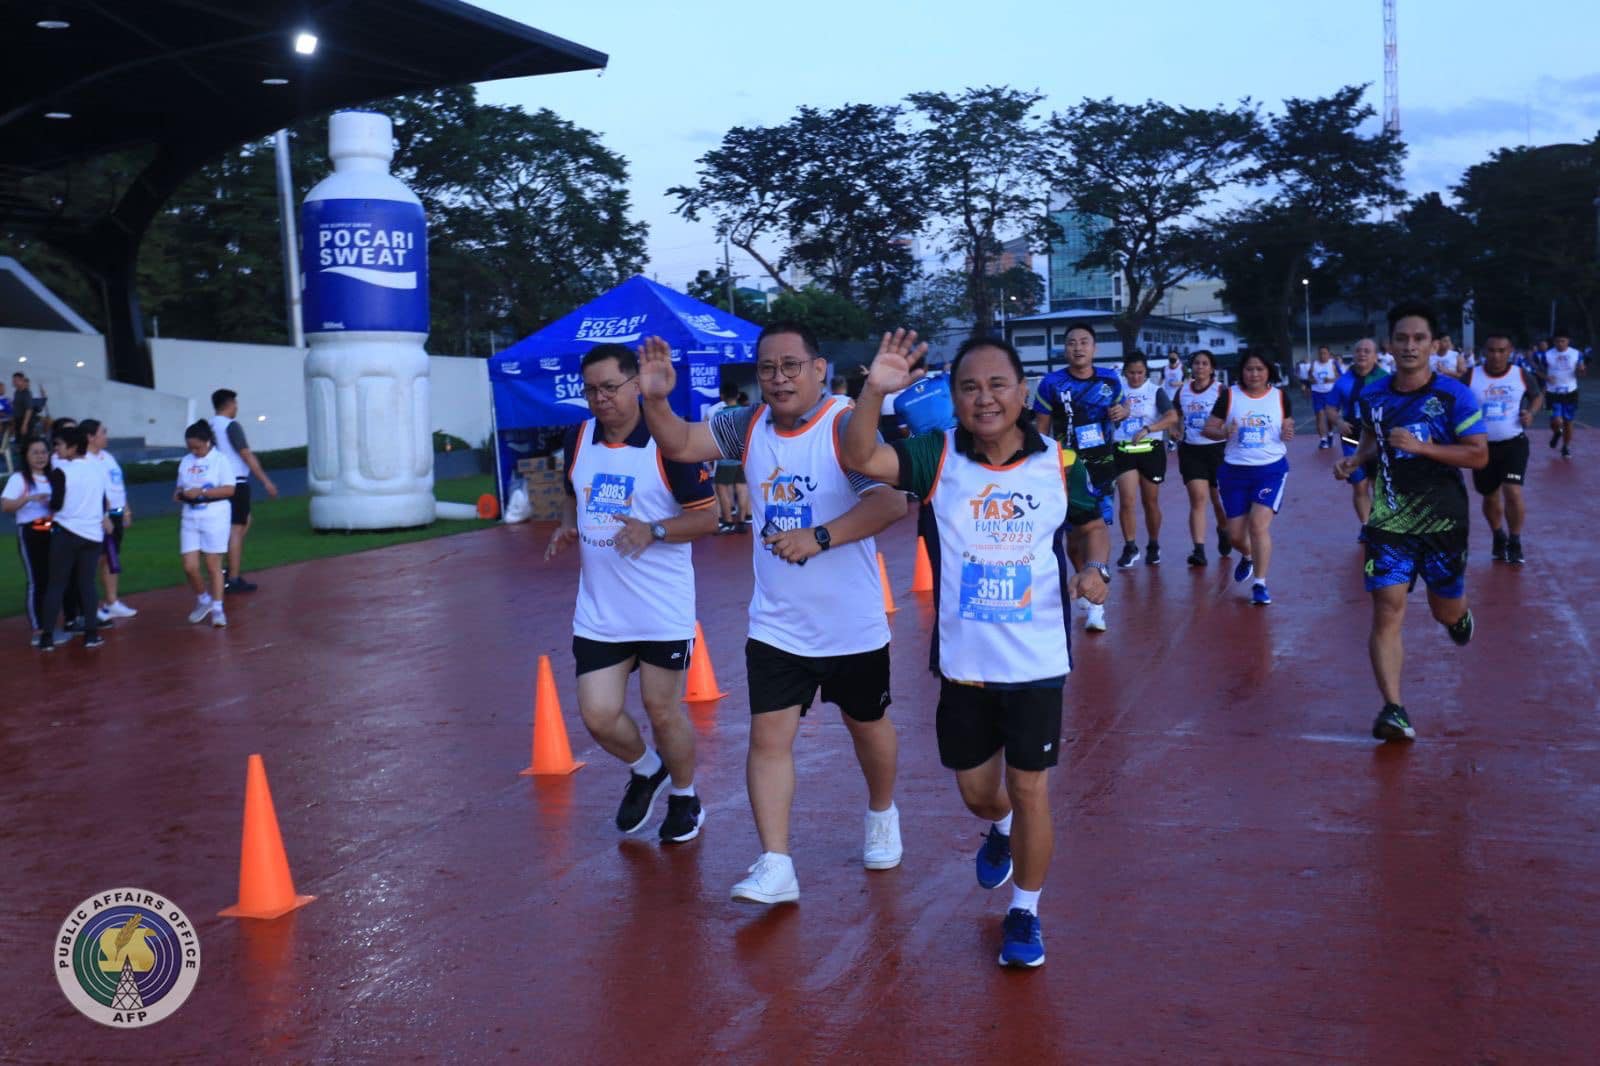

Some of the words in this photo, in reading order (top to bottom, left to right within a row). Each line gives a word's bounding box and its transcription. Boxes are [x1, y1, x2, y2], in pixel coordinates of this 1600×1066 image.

[319, 229, 414, 249] POCARI
[319, 247, 407, 266] SWEAT
[580, 313, 648, 330] POCARI
[576, 325, 637, 338] SWEAT
[690, 366, 718, 376] POCARI
[598, 482, 626, 500] 3083
[760, 481, 797, 502] TAS
[969, 499, 1015, 520] TAS
[975, 520, 1001, 533] FUN
[1006, 520, 1035, 533] RUN
[1000, 532, 1032, 544] 2023
[977, 578, 1014, 601] 3511
